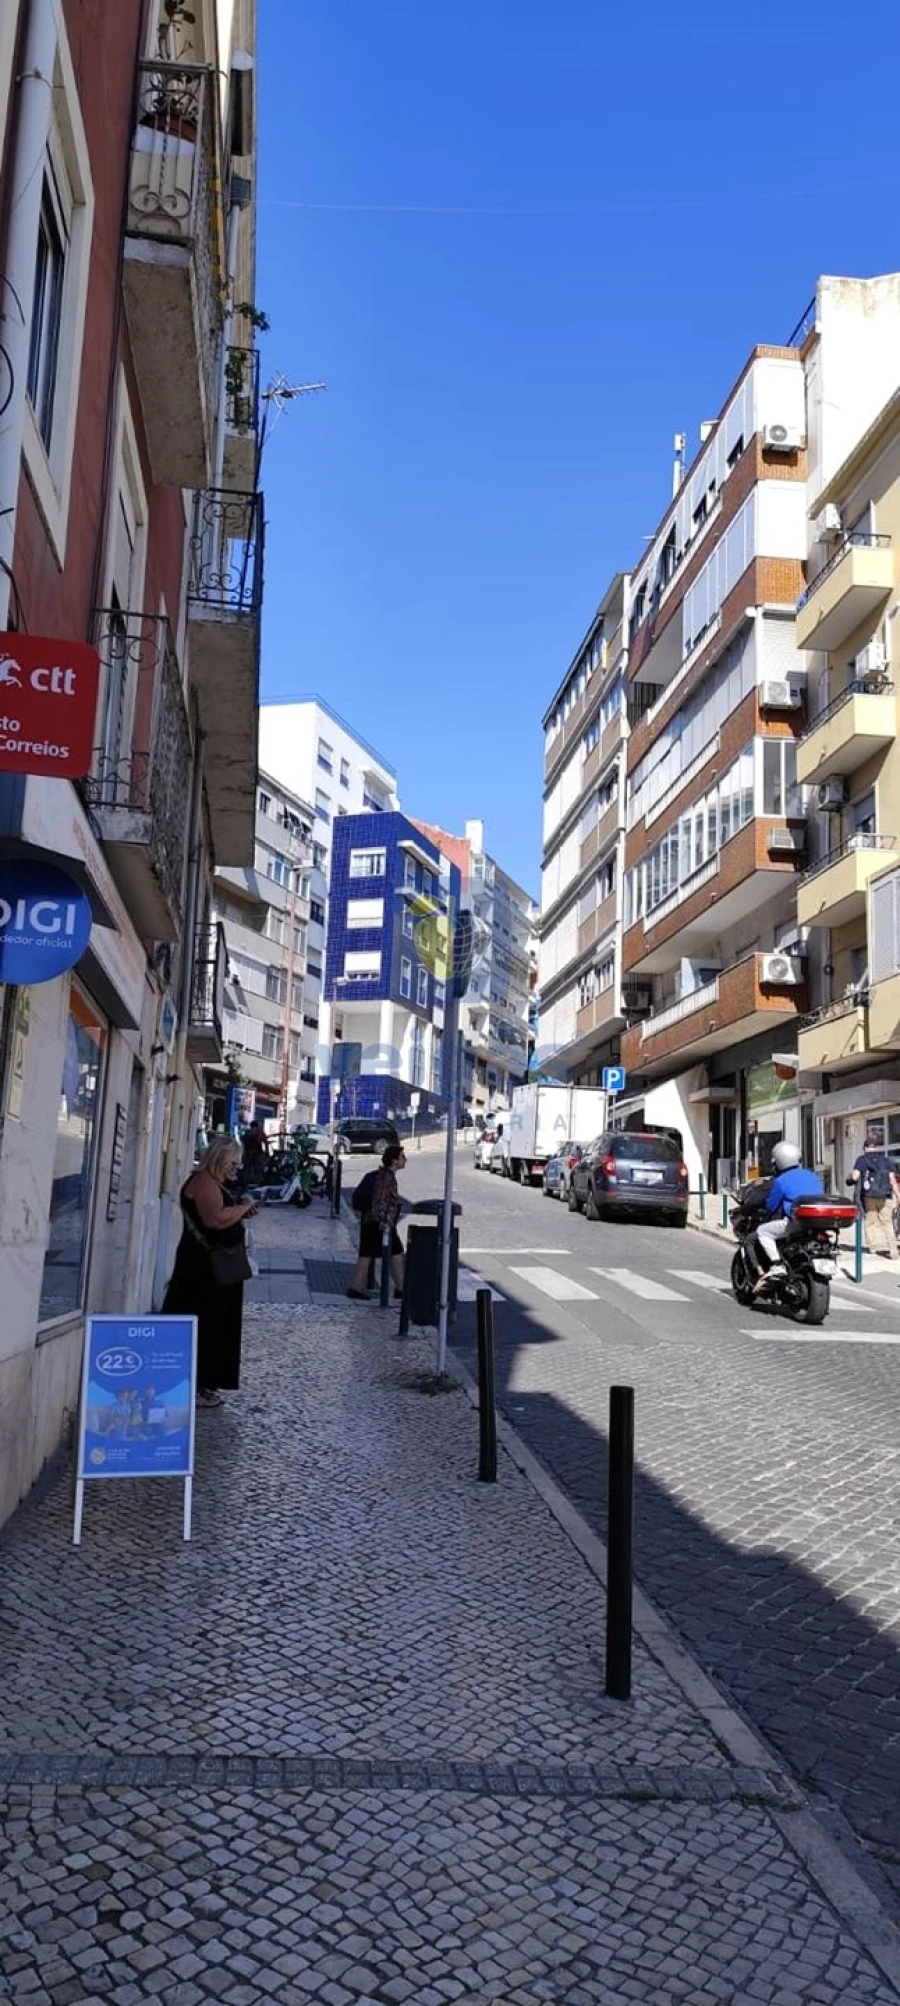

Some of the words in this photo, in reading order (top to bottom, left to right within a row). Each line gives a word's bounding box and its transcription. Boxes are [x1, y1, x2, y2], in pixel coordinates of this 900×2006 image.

[30, 666, 76, 696] ctt
[0, 715, 20, 731] to
[608, 1069, 621, 1088] P
[127, 1326, 156, 1338] DIGI
